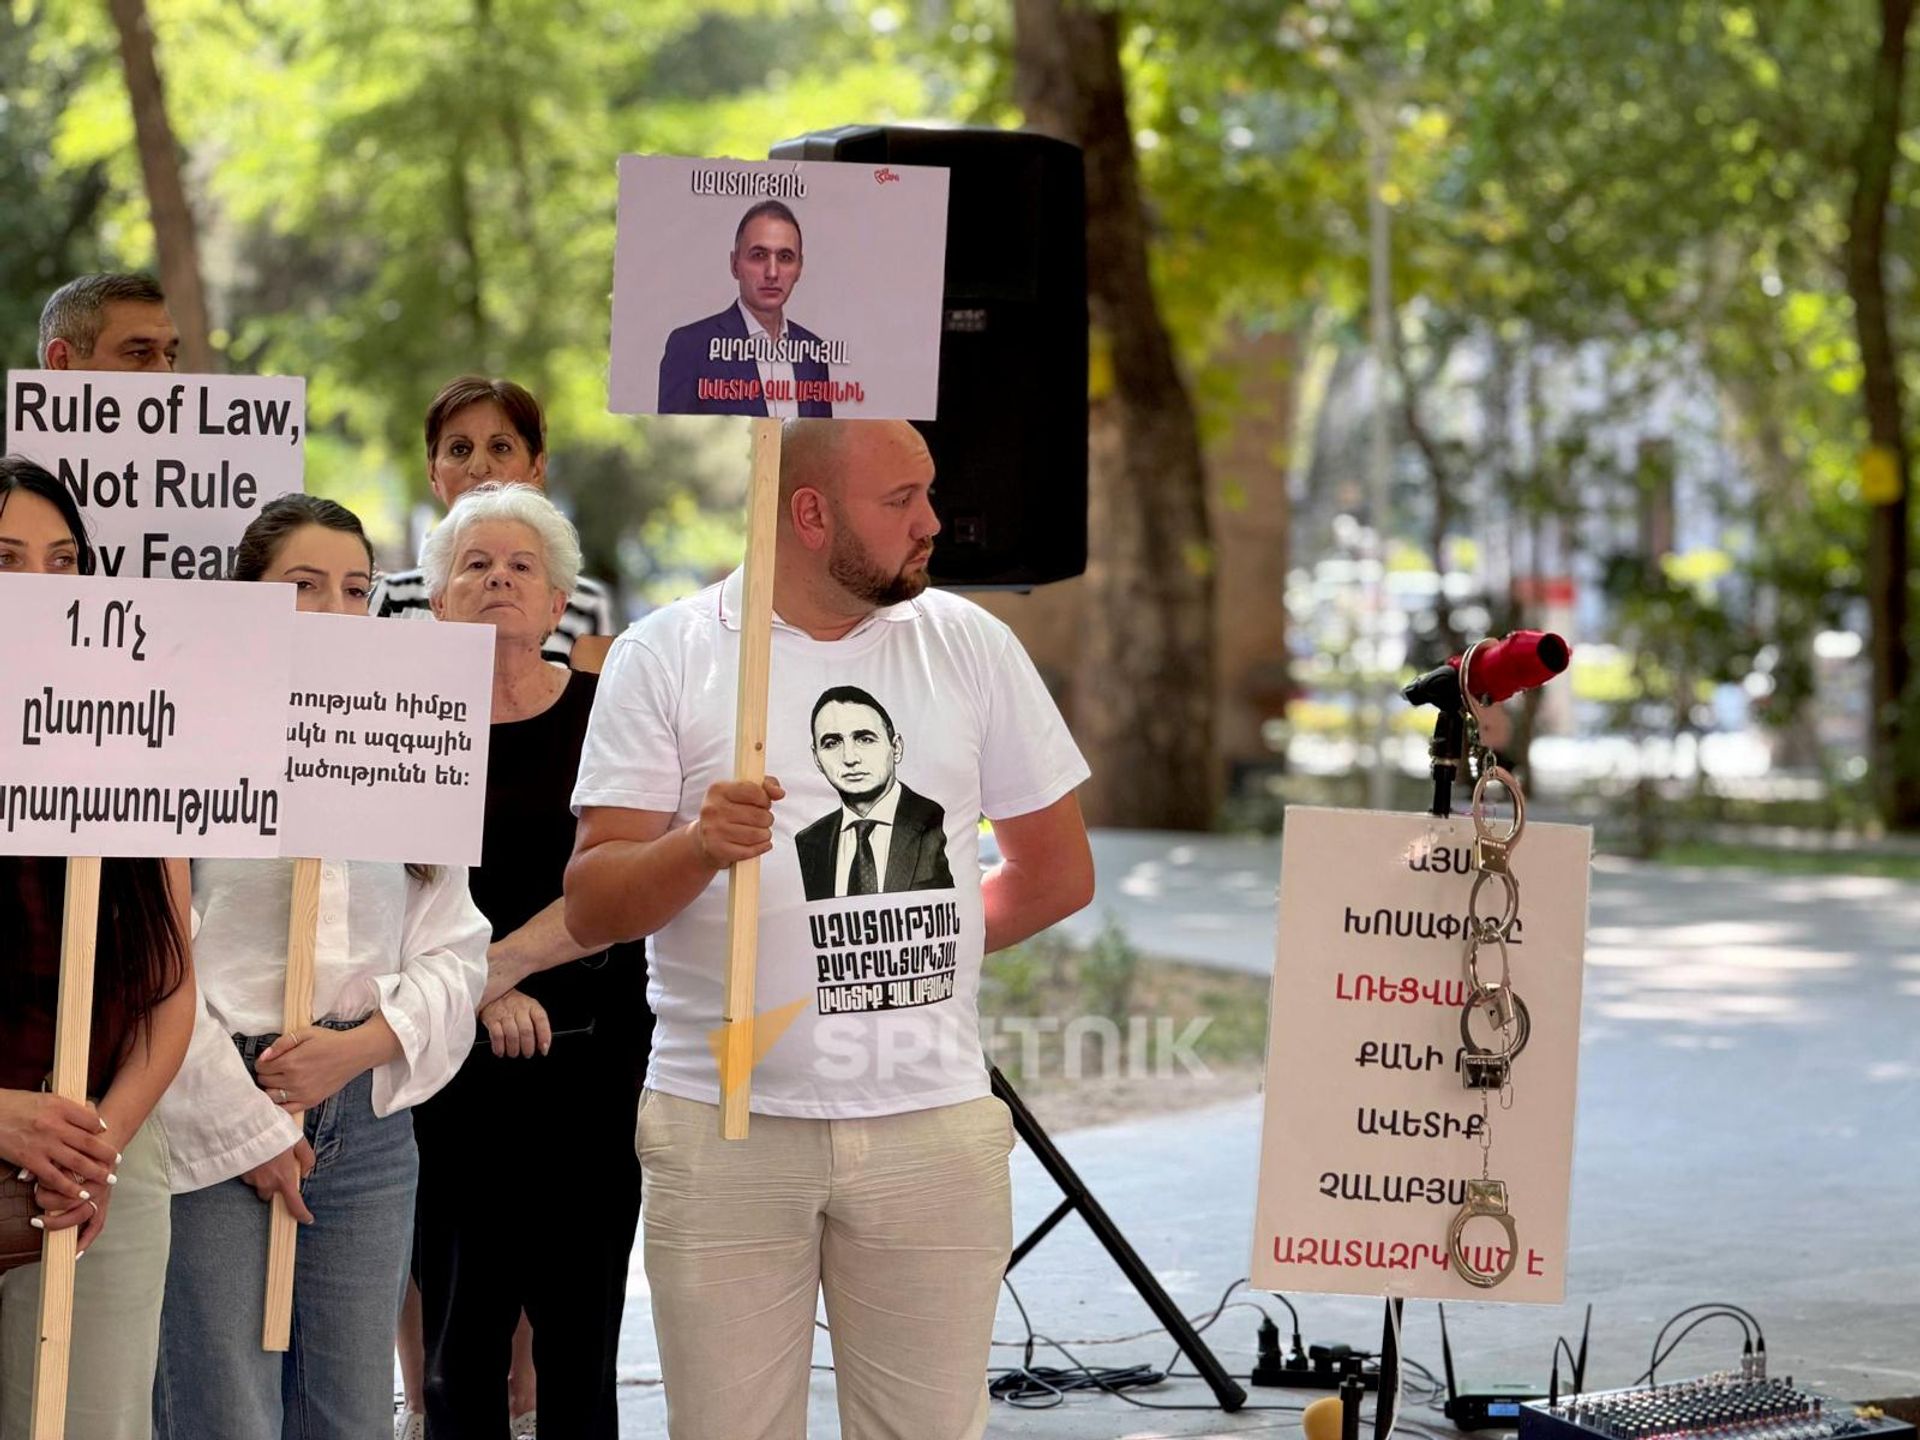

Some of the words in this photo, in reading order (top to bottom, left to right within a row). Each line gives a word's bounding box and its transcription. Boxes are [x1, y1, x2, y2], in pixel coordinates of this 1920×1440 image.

[709, 337, 850, 364] ՔԱՂԲԱՆՏԱՐԿՅԱԼ
[698, 378, 761, 401] ԱՎԵՏԻՔ
[15, 382, 120, 433] Rule
[137, 385, 184, 434] of
[199, 387, 299, 445] Law,
[58, 458, 138, 508] Not
[155, 460, 257, 508] Rule
[66, 600, 90, 647] 1.
[22, 686, 175, 748] ընտրովի
[395, 692, 467, 722] հիմքը
[335, 729, 356, 744] ու
[364, 730, 471, 756] ազգային
[809, 902, 960, 949] ԱԶԱՏՈՒԹՅՈՒՆ
[816, 941, 956, 983] ՔԱՂԲԱՆՏԱՐԿՅԱԼ
[819, 984, 884, 1013] ԱՎԵՏԻՔ
[1336, 973, 1481, 1007] ԼՌԵՑՎԱ
[1355, 1041, 1443, 1071] ՔԱՆԻ
[1357, 1108, 1484, 1139] ԱՎԵՏԻՔ
[1527, 1248, 1544, 1276] Է
